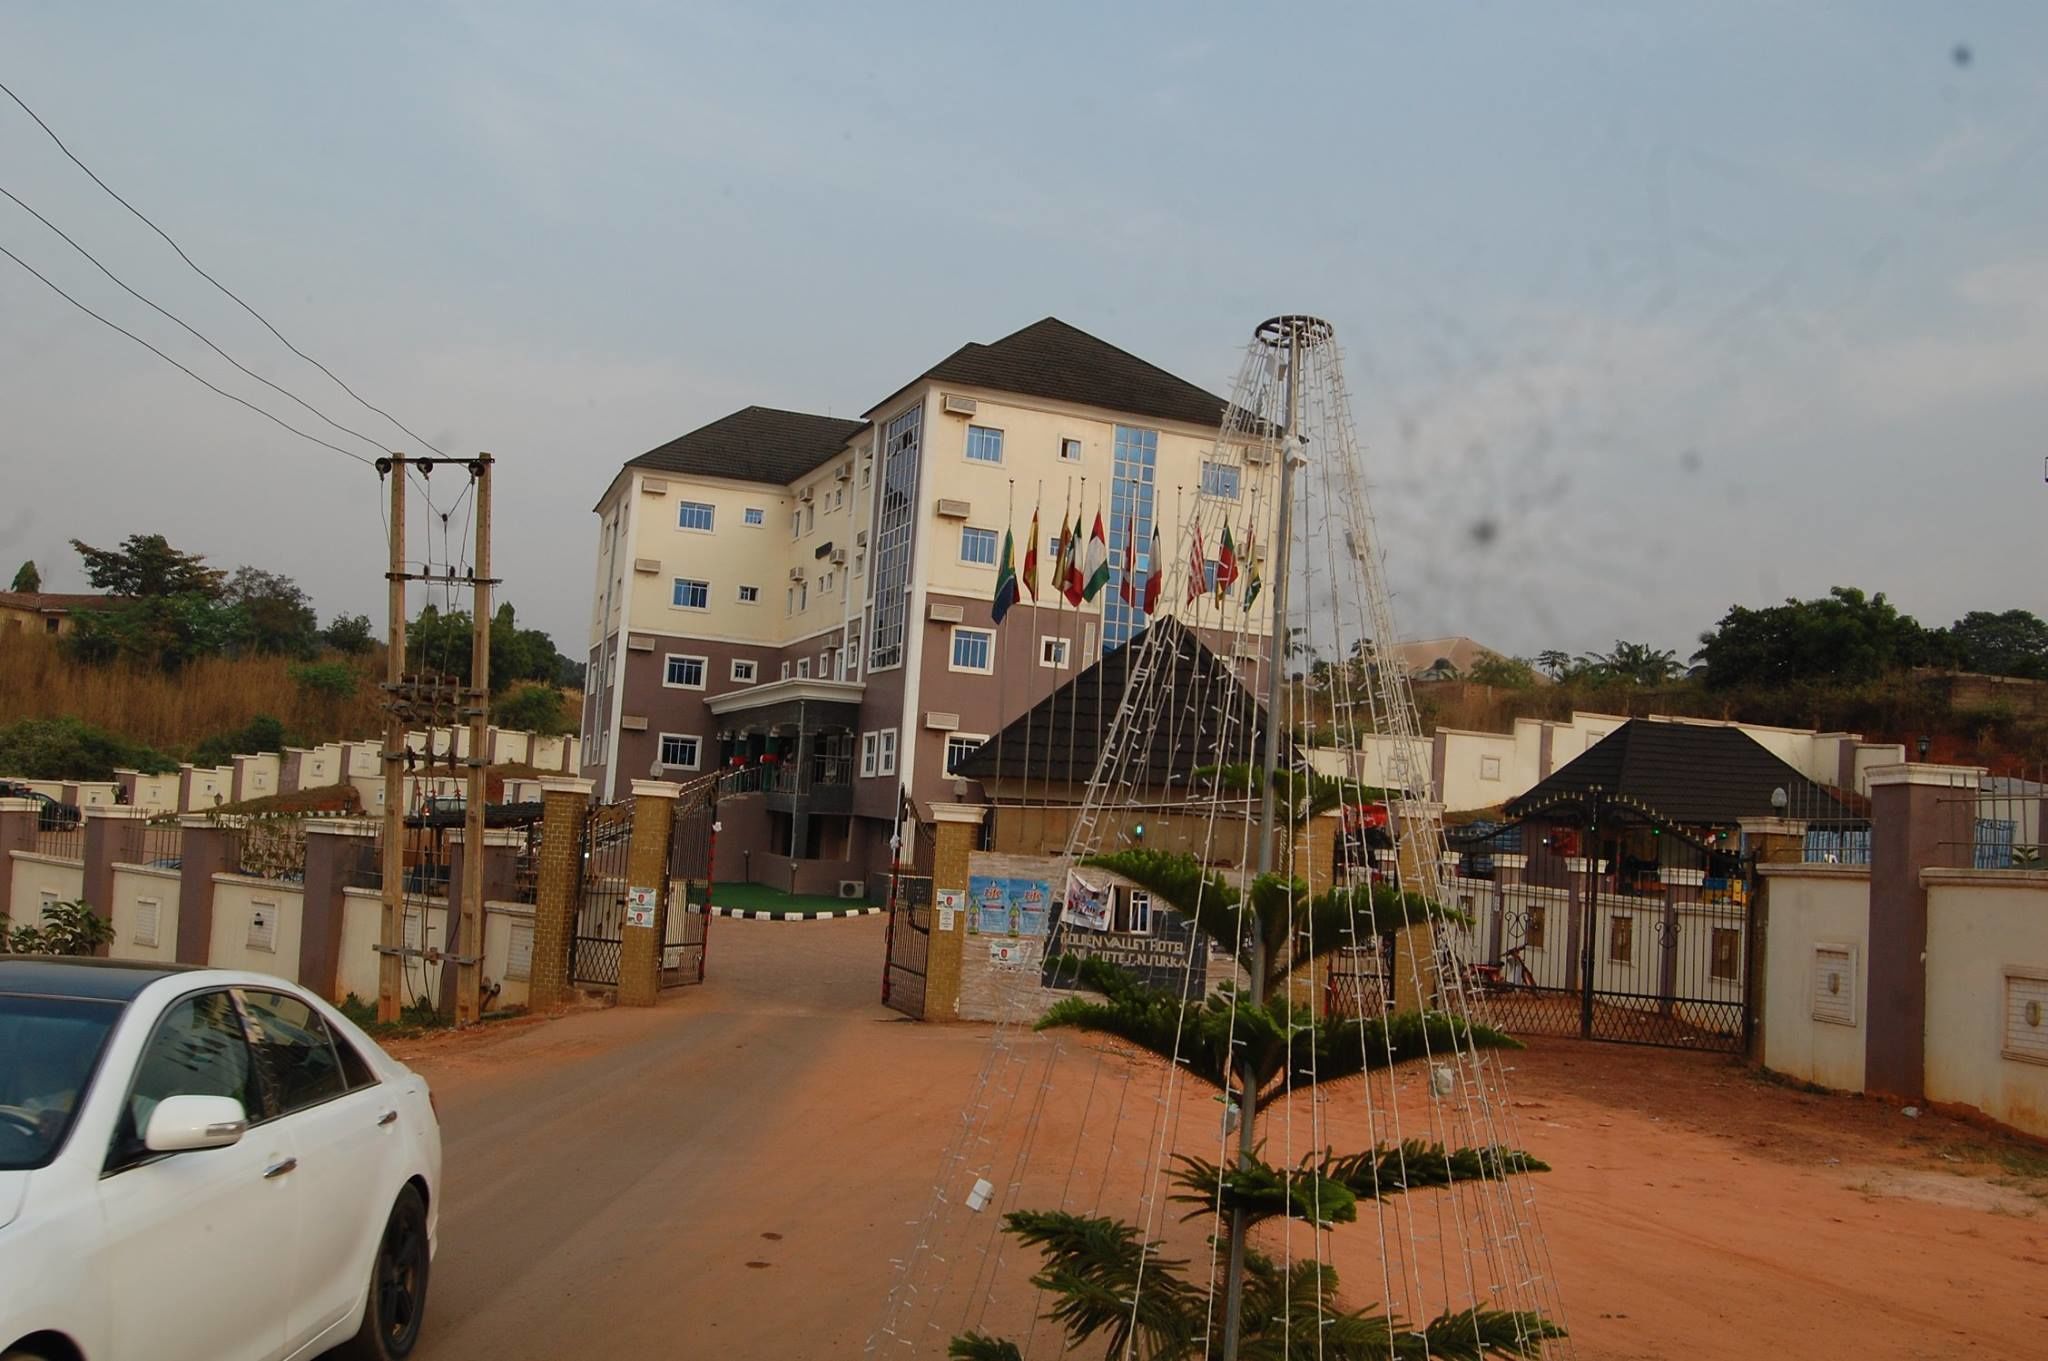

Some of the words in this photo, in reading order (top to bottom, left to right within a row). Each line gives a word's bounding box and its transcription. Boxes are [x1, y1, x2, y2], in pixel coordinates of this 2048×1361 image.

[1061, 932, 1102, 948] GOLDEN
[1103, 936, 1145, 951] VALLEY
[1150, 939, 1184, 954] HOTEL
